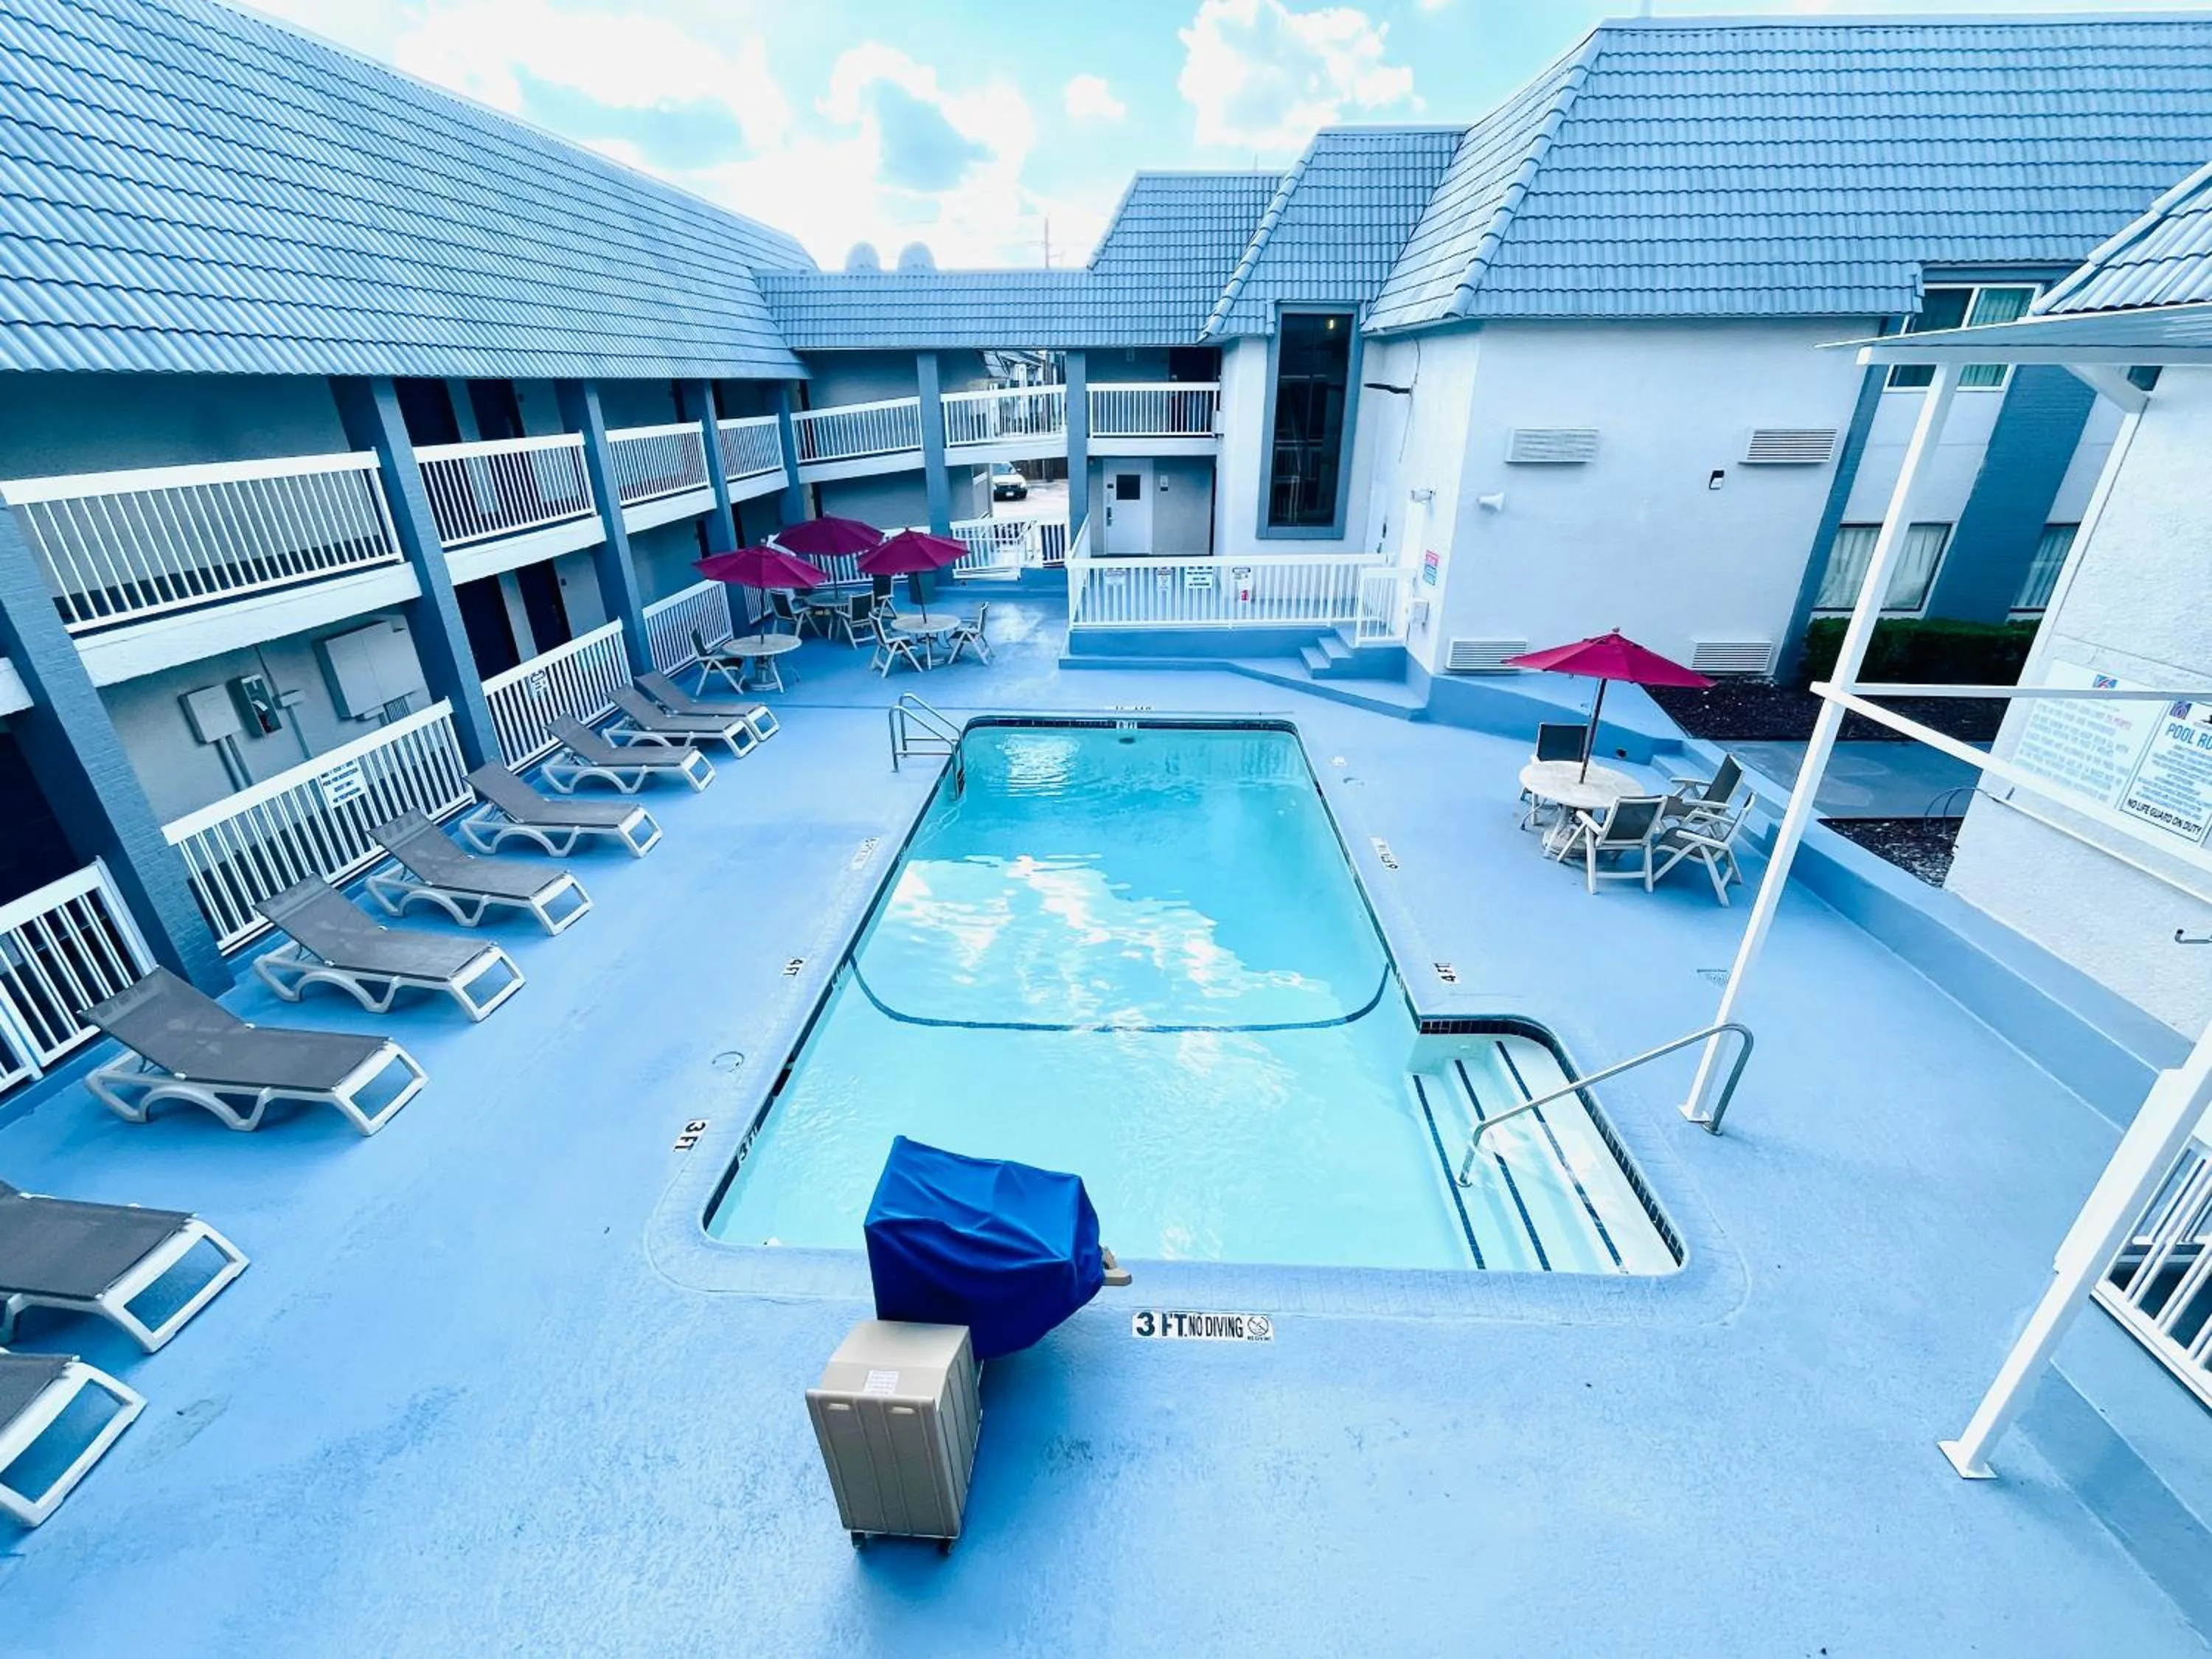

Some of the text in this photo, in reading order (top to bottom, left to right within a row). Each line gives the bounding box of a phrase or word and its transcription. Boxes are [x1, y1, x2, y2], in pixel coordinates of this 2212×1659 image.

[2166, 723, 2196, 744] POOL
[2127, 799, 2202, 835] NO LIFE GUARD ON DUTY
[1433, 963, 1456, 983] 4 FT
[674, 1121, 706, 1151] 3 FT
[1136, 1312, 1155, 1337] 3
[1189, 1316, 1203, 1337] NO
[1206, 1316, 1244, 1338] DIVING
